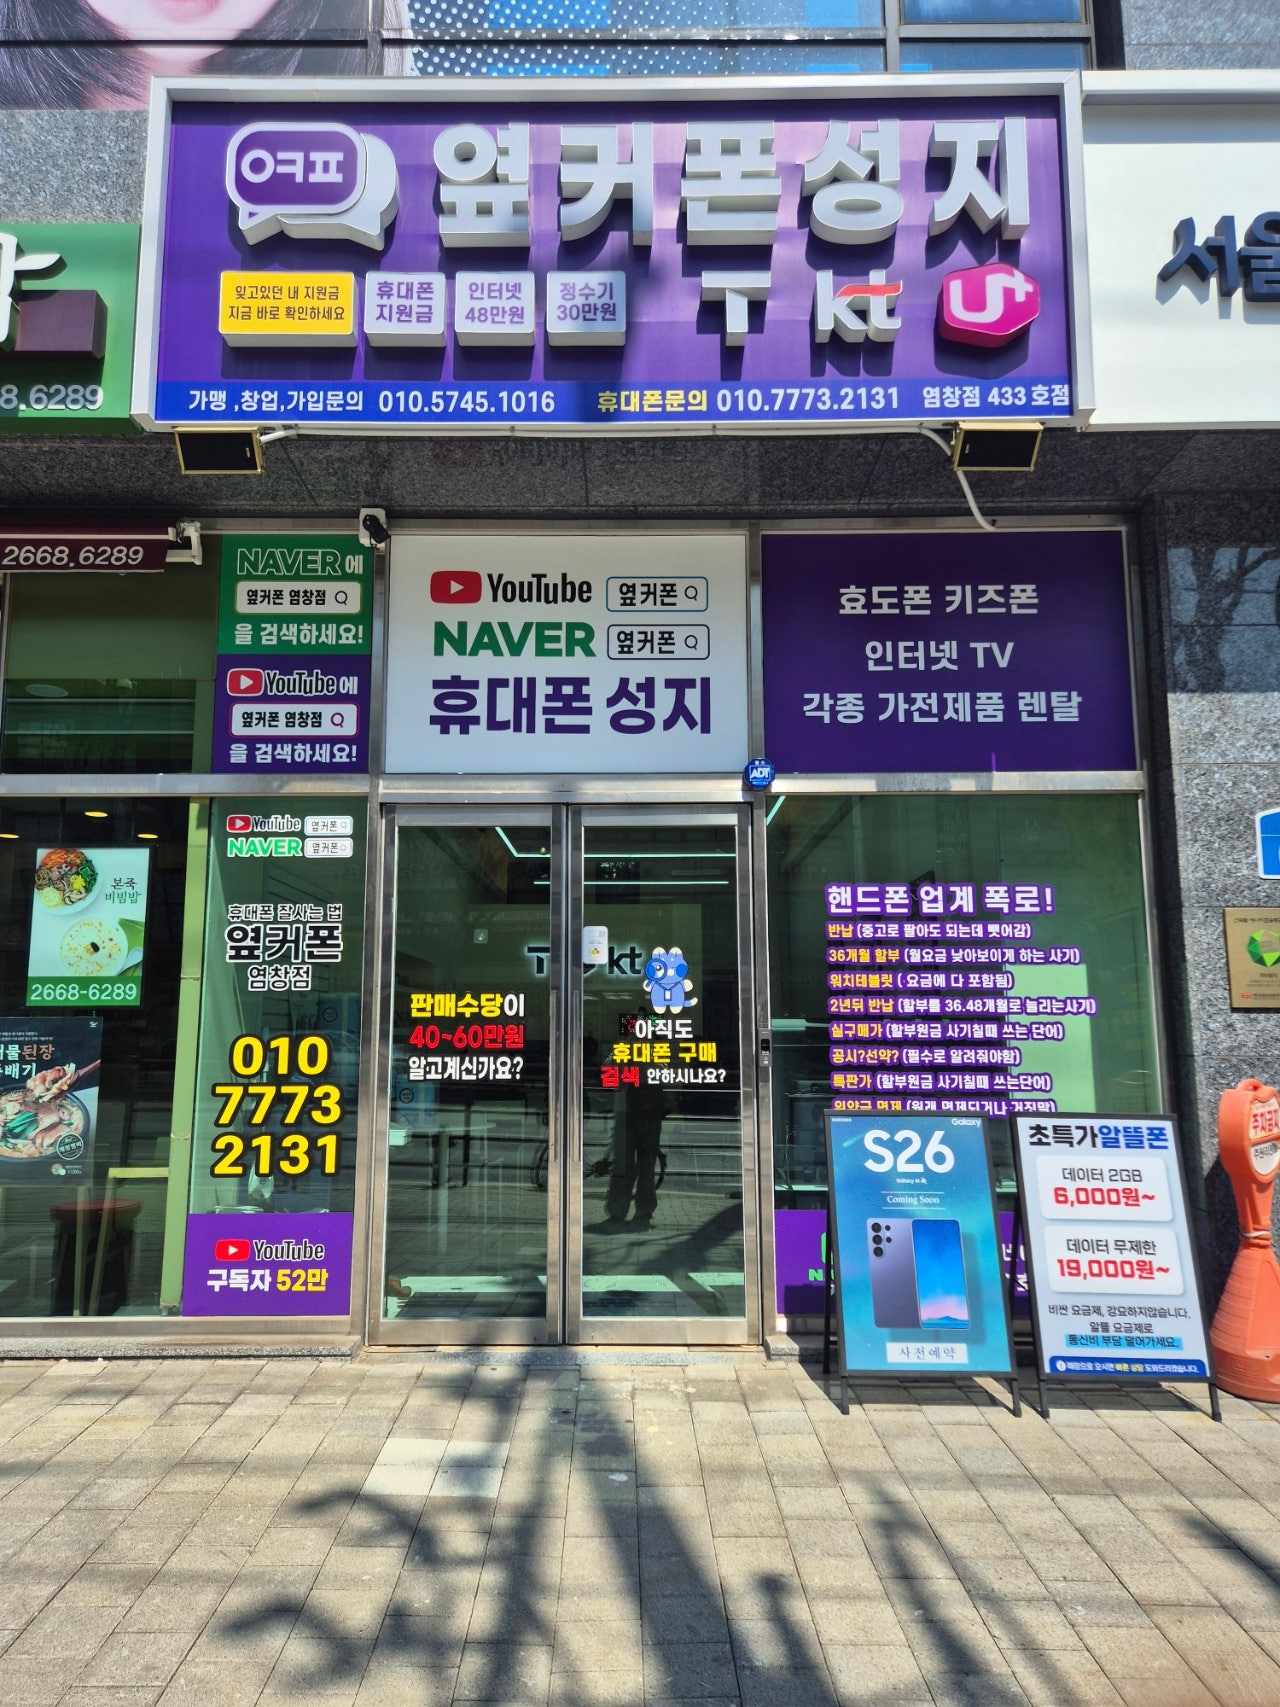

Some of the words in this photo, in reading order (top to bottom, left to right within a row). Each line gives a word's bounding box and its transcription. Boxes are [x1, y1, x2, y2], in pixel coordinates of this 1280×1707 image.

[433, 117, 1030, 246] 옆커폰성지
[235, 285, 283, 300] 잊고있던
[288, 286, 299, 300] 내
[304, 286, 339, 300] 지원금
[376, 281, 434, 300] 휴대폰
[468, 281, 523, 301] 인터넷
[559, 281, 614, 301] 정수기
[228, 306, 252, 320] 지금
[257, 306, 280, 320] 바로
[285, 306, 345, 320] 확인하세요
[375, 303, 434, 323] 지원금
[465, 304, 526, 324] 48만원
[556, 302, 617, 322] 30만원
[815, 269, 903, 342] kt
[378, 390, 556, 412] 010.5745.1016
[598, 389, 708, 413] 휴대폰문의
[716, 387, 900, 412] 010.7773.2131
[922, 385, 981, 408] 염창점
[1, 546, 144, 567] 2668.6289
[246, 589, 284, 605] 옆커폰
[288, 589, 326, 605] 염창점
[487, 573, 592, 604] YouTube
[619, 582, 678, 606] 옆커폰
[839, 584, 932, 616] 효도폰
[945, 584, 1039, 615] 키즈폰
[234, 623, 252, 645] 을
[260, 623, 363, 645] 검색하세요!
[433, 620, 597, 657] NAVER
[616, 630, 676, 655] 옆커폰
[865, 640, 959, 671] 인터넷
[969, 642, 1015, 668] TV
[430, 675, 593, 735] 휴대폰
[606, 676, 711, 735] 성지
[803, 692, 866, 723] 각종
[878, 692, 1005, 723] 가전제품
[1018, 691, 1083, 722] 렌탈
[241, 711, 280, 728] 옆커폰
[284, 711, 322, 728] 염창점
[229, 744, 248, 763] 을
[255, 743, 357, 763] 검색하세요!
[751, 767, 771, 779] ADT
[253, 815, 302, 832] YouTube
[311, 820, 338, 832] 옆커폰
[228, 838, 303, 857] NAVER
[312, 842, 338, 854] 옆커폰
[111, 877, 138, 890] 본죽
[105, 890, 142, 904] 비빔밥
[827, 885, 911, 913] 핸드폰
[919, 885, 975, 913] 업계
[984, 885, 1053, 913] 폭로!
[228, 904, 274, 921] 휴대폰
[278, 904, 323, 921] 잘사는
[327, 904, 342, 920] 법
[827, 923, 854, 938] 반납
[857, 923, 900, 938] (중고로
[903, 923, 942, 938] 팔아도
[945, 923, 984, 938] 되는데
[225, 924, 343, 962] 옆커폰
[829, 948, 871, 963] 36개월
[874, 948, 900, 963] 할부
[904, 947, 948, 963] (월요금
[951, 948, 1015, 963] 낮아보이게
[1019, 948, 1045, 963] 하는
[1049, 947, 1080, 964] 사기)
[248, 965, 312, 991] 염창점
[951, 974, 964, 988] 다
[968, 973, 1012, 989] 포함됨)
[30, 983, 137, 1001] 2668-6289
[410, 993, 525, 1018] 판매수당이
[830, 998, 864, 1014] 2년뒤
[868, 998, 894, 1014] 반납
[898, 998, 941, 1014] (할부를
[945, 998, 1023, 1014] 36.48개월로
[409, 1025, 524, 1049] 40~60만원
[634, 1019, 694, 1039] 아직도
[831, 1023, 883, 1038] 실구매가
[886, 1023, 942, 1039] (할부원금
[946, 1023, 998, 1039] 사기칠때
[1002, 1023, 1028, 1038] 쓰는
[1031, 1023, 1063, 1040] 단어)
[232, 1036, 329, 1075] 010
[612, 1042, 672, 1063] 휴대폰
[678, 1042, 717, 1063] 구매
[832, 1048, 899, 1064] 공시?선약?
[902, 1048, 947, 1064] (필수로
[950, 1048, 1020, 1065] 알려줘야함)
[409, 1056, 524, 1081] 알고계신가요?
[600, 1066, 640, 1088] 검색
[647, 1068, 727, 1084] 안하시나요?
[833, 1074, 872, 1089] 특판가
[876, 1074, 933, 1090] (할부원금
[937, 1074, 989, 1090] 사기칠때
[215, 1084, 342, 1124] 7773
[951, 1118, 982, 1127] Galaxy
[213, 1134, 338, 1175] 2131
[863, 1129, 955, 1173] S26
[1061, 1167, 1104, 1183] 데이터
[1108, 1168, 1143, 1183] 2GB
[886, 1195, 918, 1205] Coming
[919, 1195, 940, 1204] Soon
[1053, 1187, 1156, 1208] 6,000원~
[253, 1239, 325, 1261] YouTube
[1066, 1238, 1109, 1254] 데이터
[1113, 1239, 1157, 1256] 무제한
[1056, 1258, 1170, 1280] 19,000원~
[206, 1268, 272, 1292] 구독자
[276, 1268, 329, 1292] 52만
[1048, 1304, 1069, 1316] 비싼
[1089, 1322, 1110, 1334] 알뜰
[1113, 1322, 1154, 1334] 요금제로
[1068, 1334, 1099, 1346] 통신비
[1102, 1335, 1122, 1347] 부담
[899, 1346, 957, 1361] 사전예약
